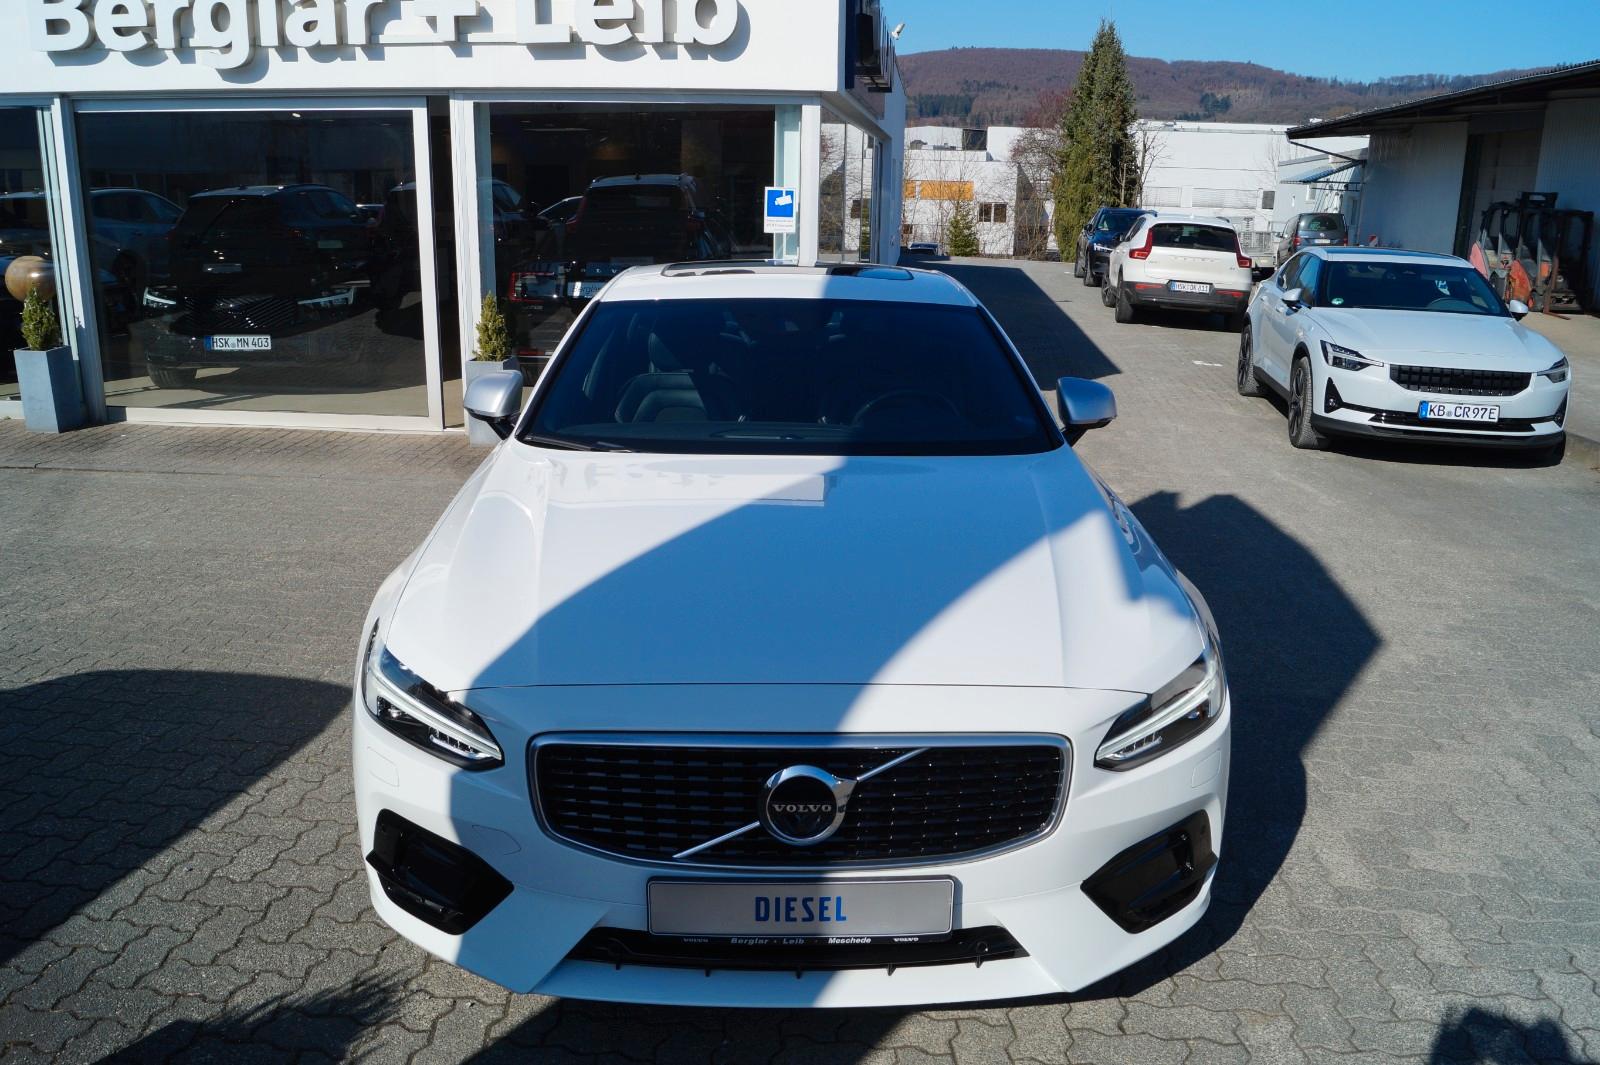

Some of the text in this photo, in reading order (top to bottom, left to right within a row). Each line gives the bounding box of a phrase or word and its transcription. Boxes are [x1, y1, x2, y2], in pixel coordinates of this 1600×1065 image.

[35, 0, 375, 69] Berglar
[212, 338, 269, 348] HSK MN 403
[1429, 404, 1446, 416] KB
[772, 804, 832, 812] VOLVO
[755, 896, 847, 922] DIESEL
